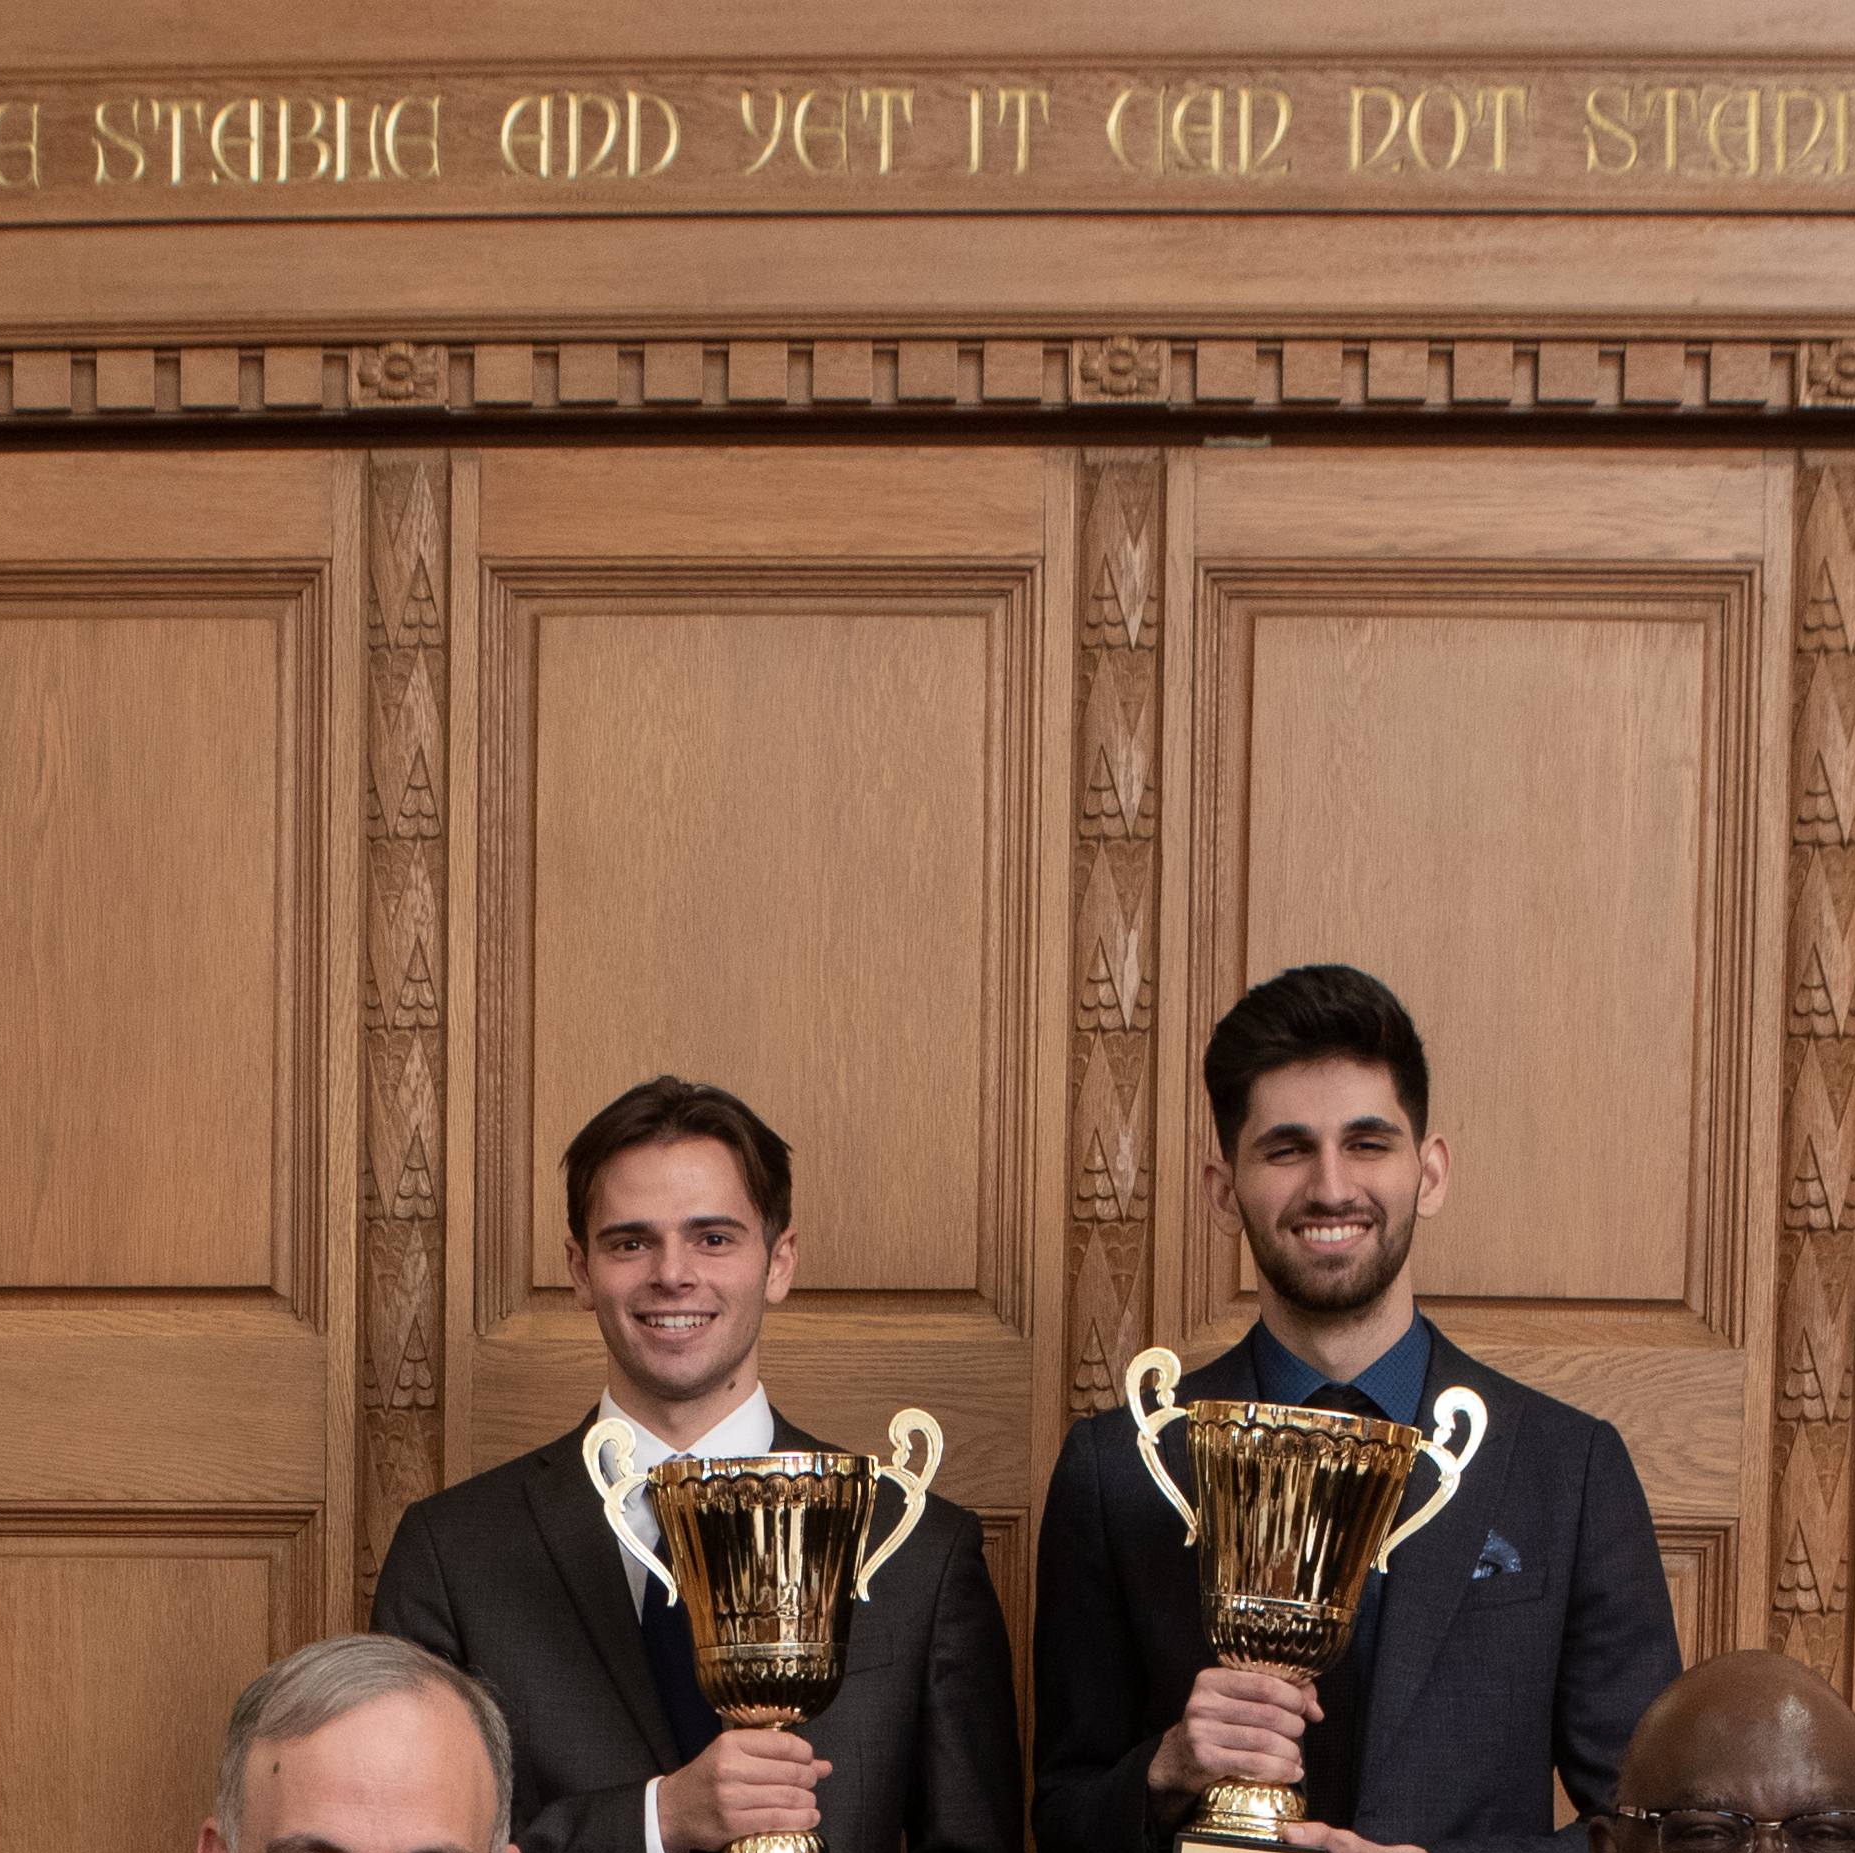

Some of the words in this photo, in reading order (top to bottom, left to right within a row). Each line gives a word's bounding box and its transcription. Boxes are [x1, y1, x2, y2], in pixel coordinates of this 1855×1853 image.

[91, 95, 442, 185] STABLE
[500, 89, 682, 180] AND
[740, 87, 915, 177] YET
[969, 87, 1050, 176] IT
[1105, 84, 1294, 176] CAN
[1350, 84, 1529, 175] NOT
